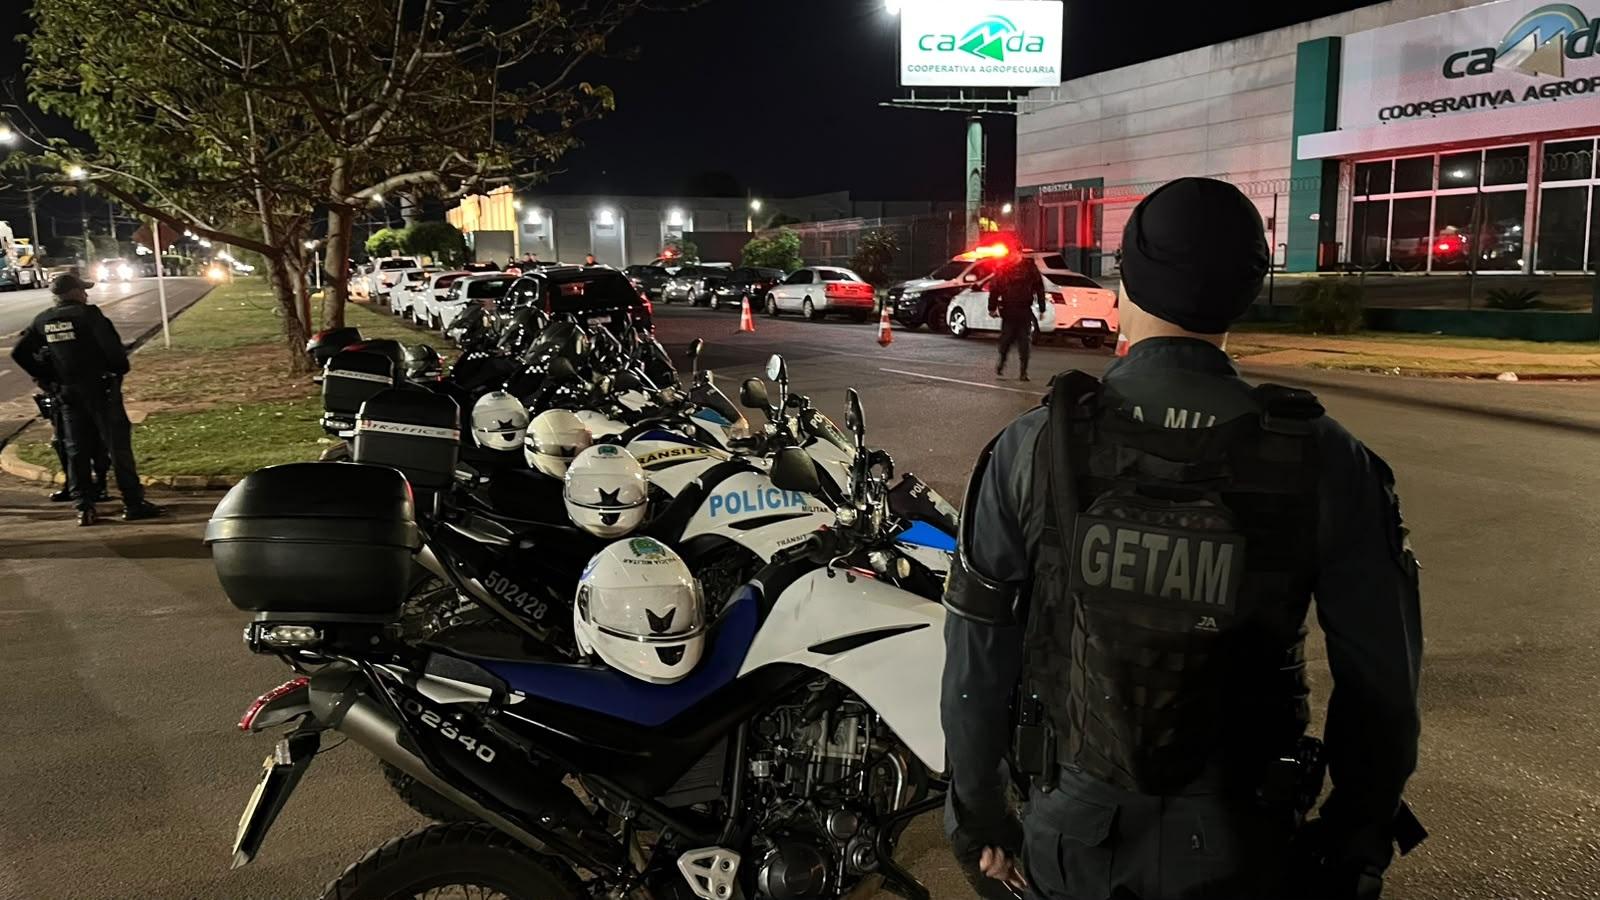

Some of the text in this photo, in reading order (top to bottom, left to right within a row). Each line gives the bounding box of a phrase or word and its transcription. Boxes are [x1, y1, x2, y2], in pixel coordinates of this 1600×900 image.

[907, 64, 1055, 73] COOPERATIVA AGROPECUARIA
[1378, 89, 1516, 121] COOPERATIVA
[637, 447, 710, 464] RANSITO
[710, 484, 808, 518] POLÍCIA
[1081, 523, 1234, 606] GETAM
[484, 570, 548, 620] 502428
